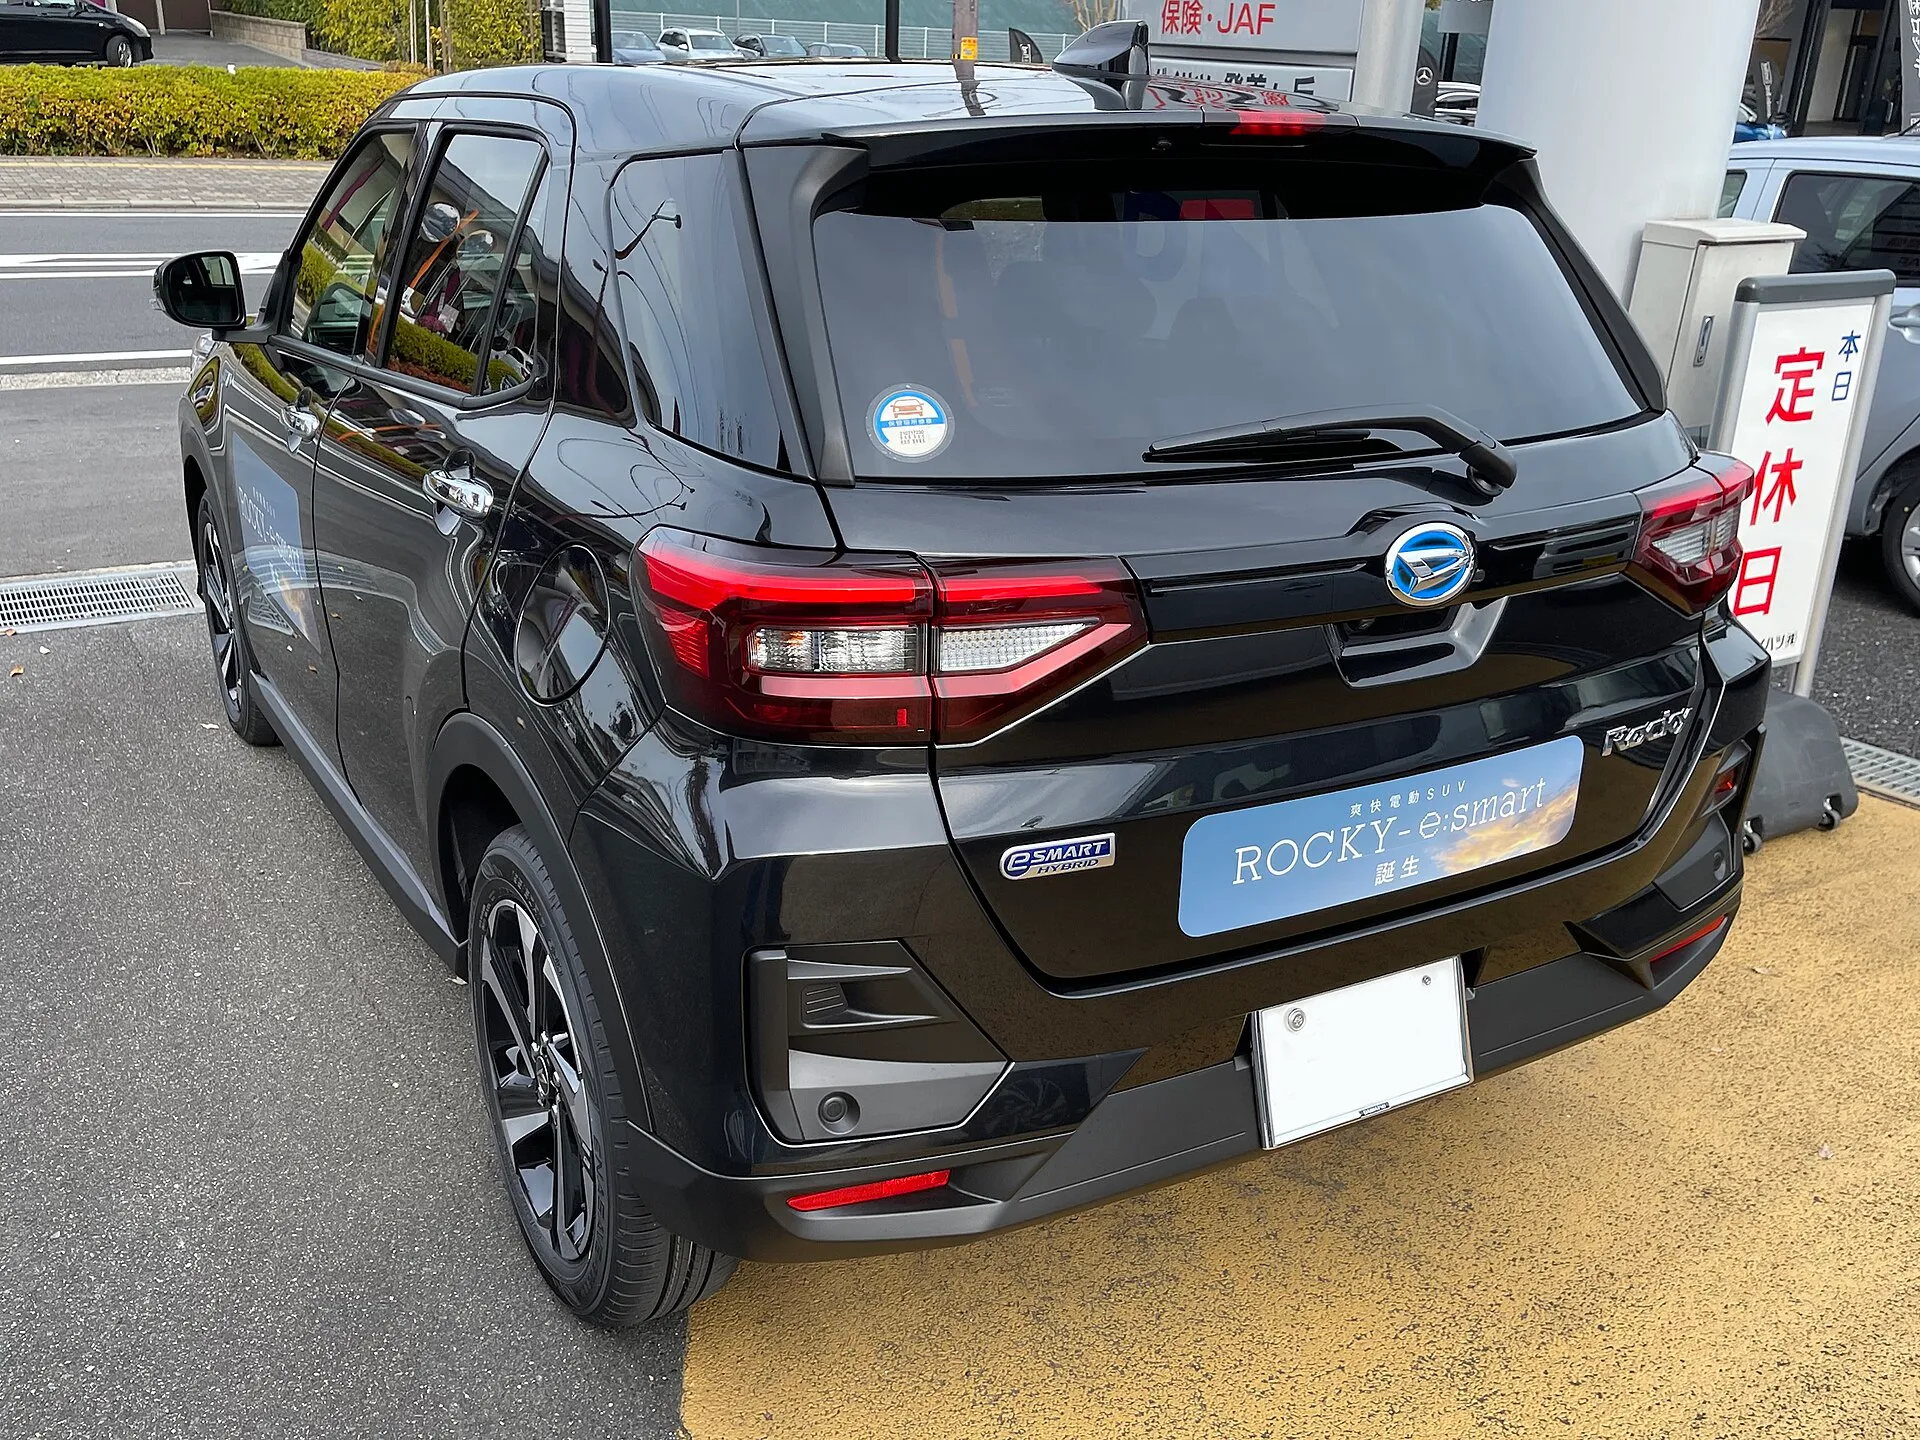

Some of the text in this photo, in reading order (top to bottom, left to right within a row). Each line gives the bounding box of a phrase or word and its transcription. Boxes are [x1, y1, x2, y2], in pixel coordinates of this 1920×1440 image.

[1161, 0, 1276, 34] 保険・JAF
[1831, 330, 1861, 401] 本日
[1733, 346, 1825, 617] 定休日
[1037, 859, 1099, 874] HYBRID
[1374, 855, 1420, 886] 誕生
